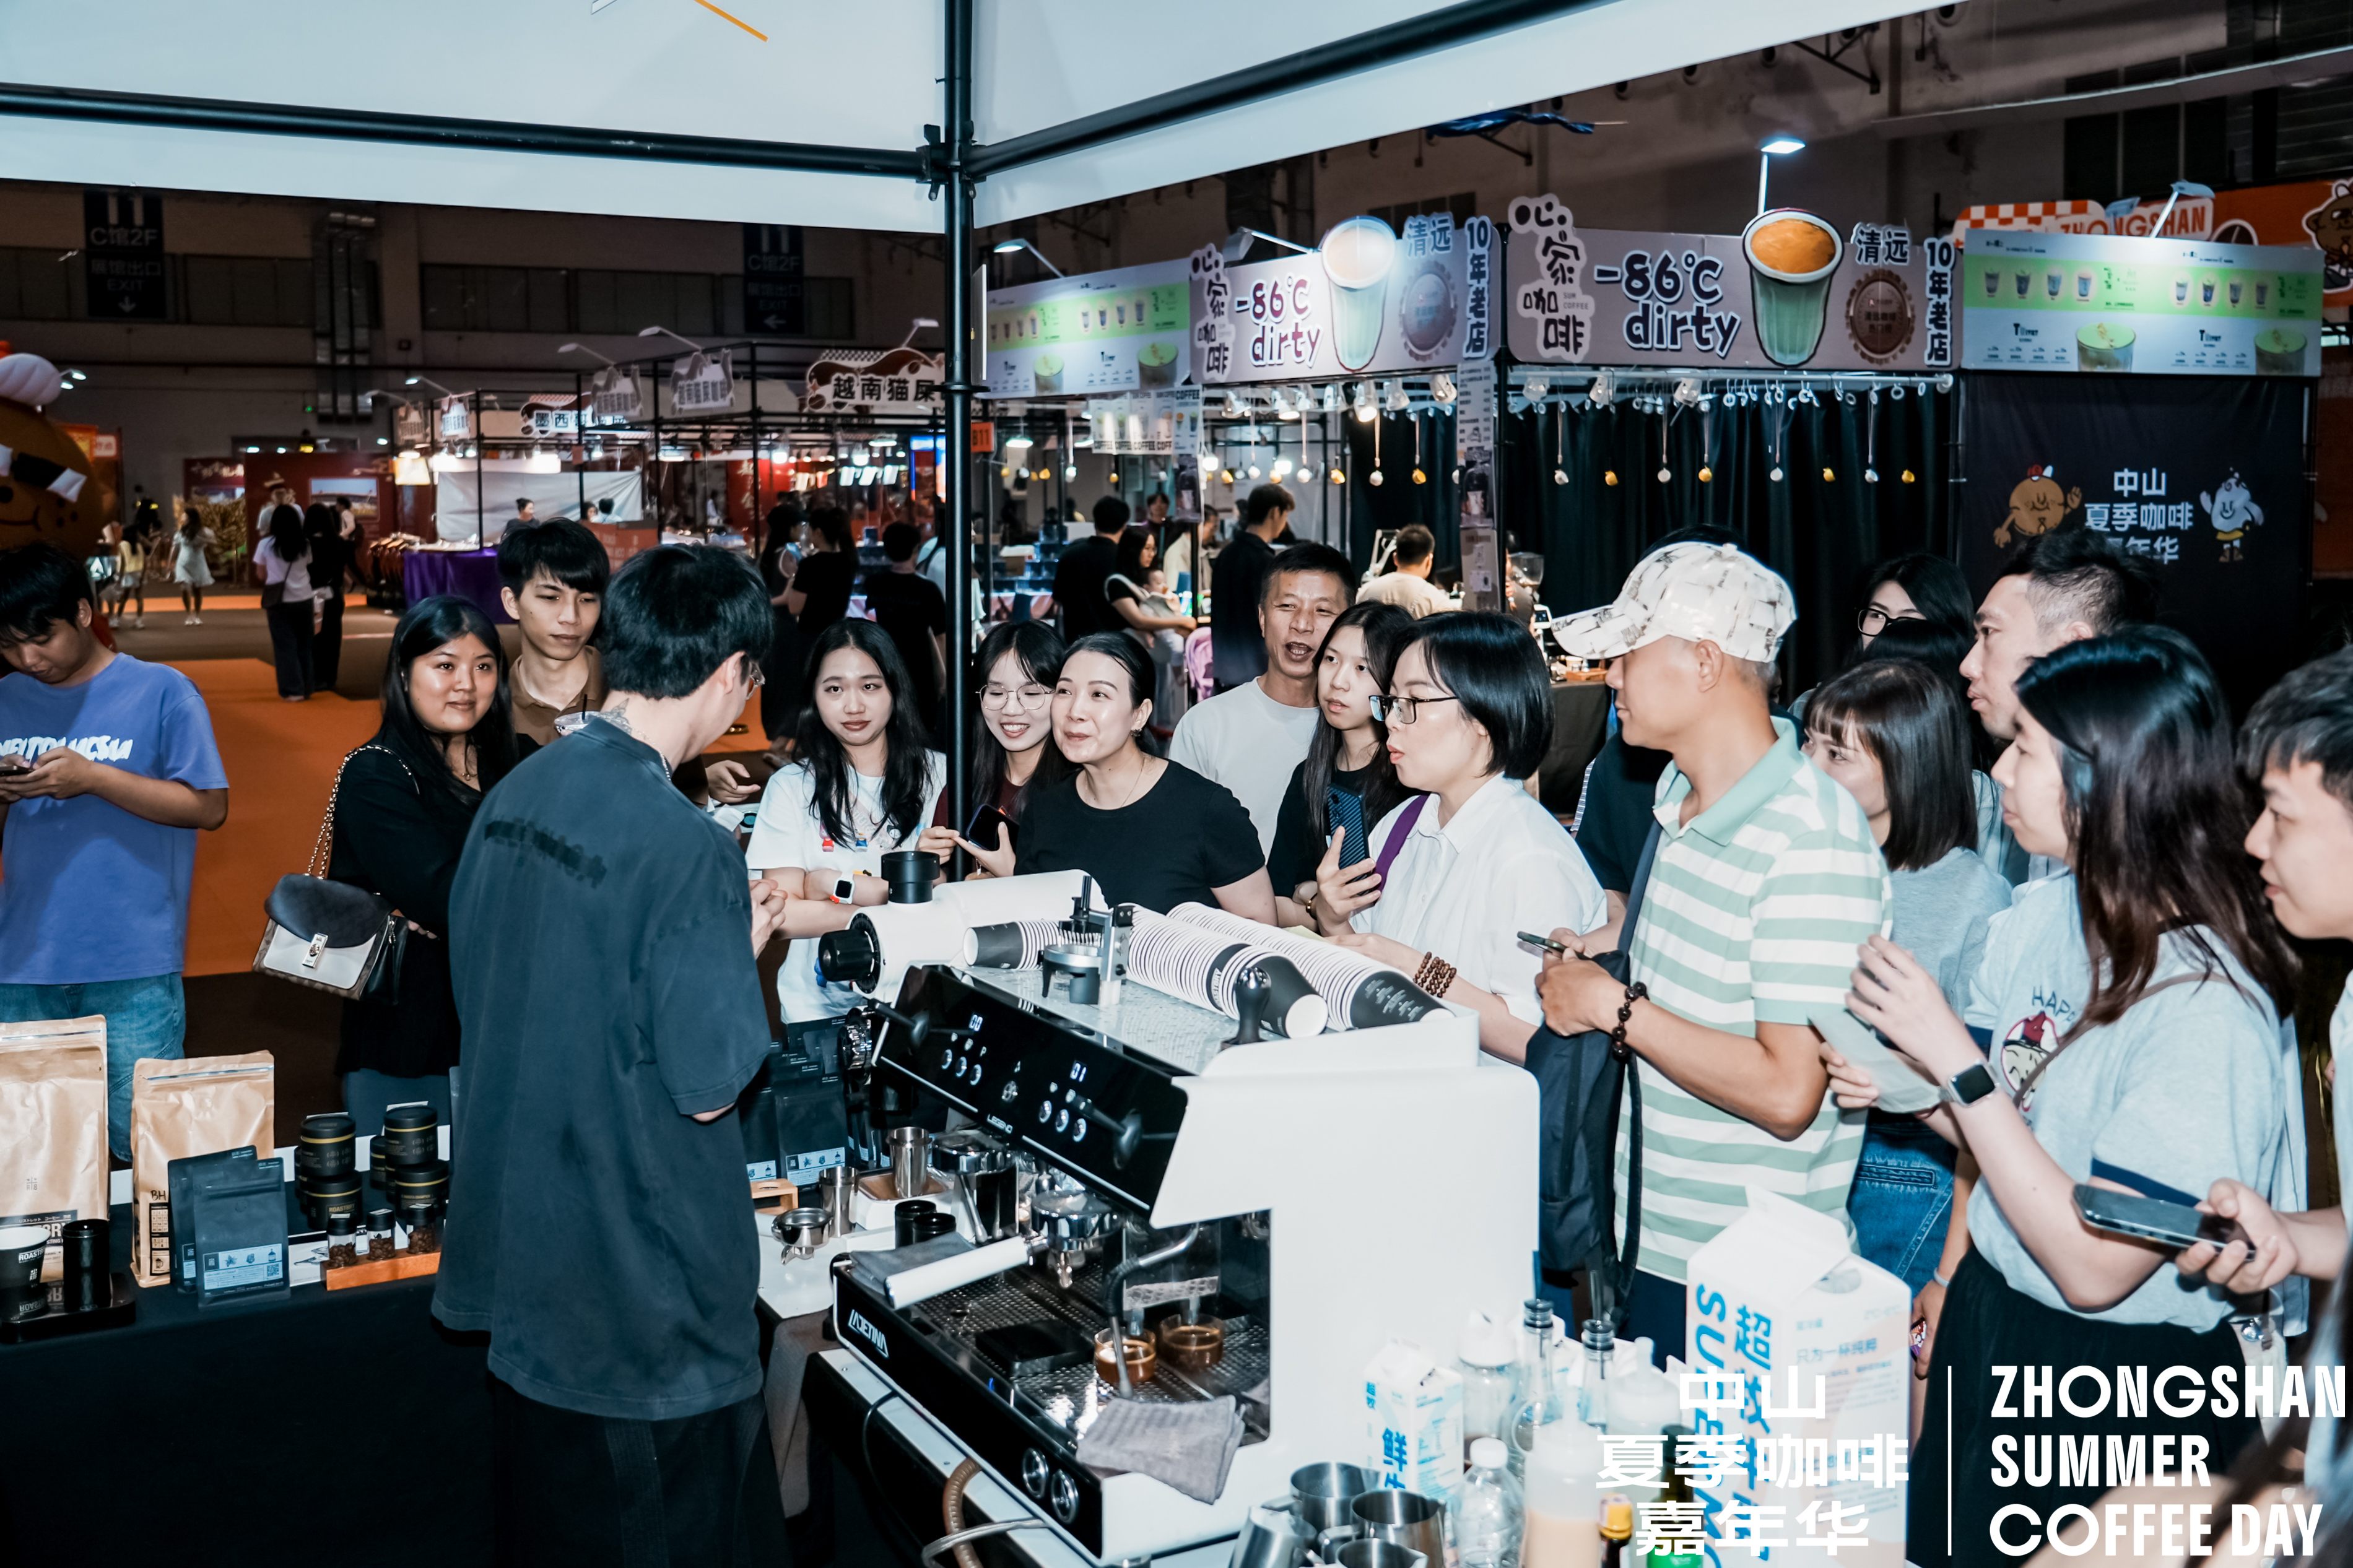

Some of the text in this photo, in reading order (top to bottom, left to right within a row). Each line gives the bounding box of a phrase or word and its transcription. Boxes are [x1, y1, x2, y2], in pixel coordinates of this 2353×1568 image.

[90, 227, 159, 246] C馆2F
[1407, 218, 1451, 256] 清远
[1857, 228, 1908, 264] 清远
[107, 279, 145, 291] EXIT
[1466, 220, 1487, 358] 10年老店
[1563, 302, 1588, 310] COFFEE
[1927, 241, 1952, 362] 10年老店
[1252, 322, 1321, 365] dirty
[1625, 305, 1739, 357] dirty
[833, 375, 946, 402] 越南猫屎
[2113, 467, 2167, 497] 中山
[2084, 501, 2193, 532] 夏季咖啡
[150, 1189, 167, 1201] BH
